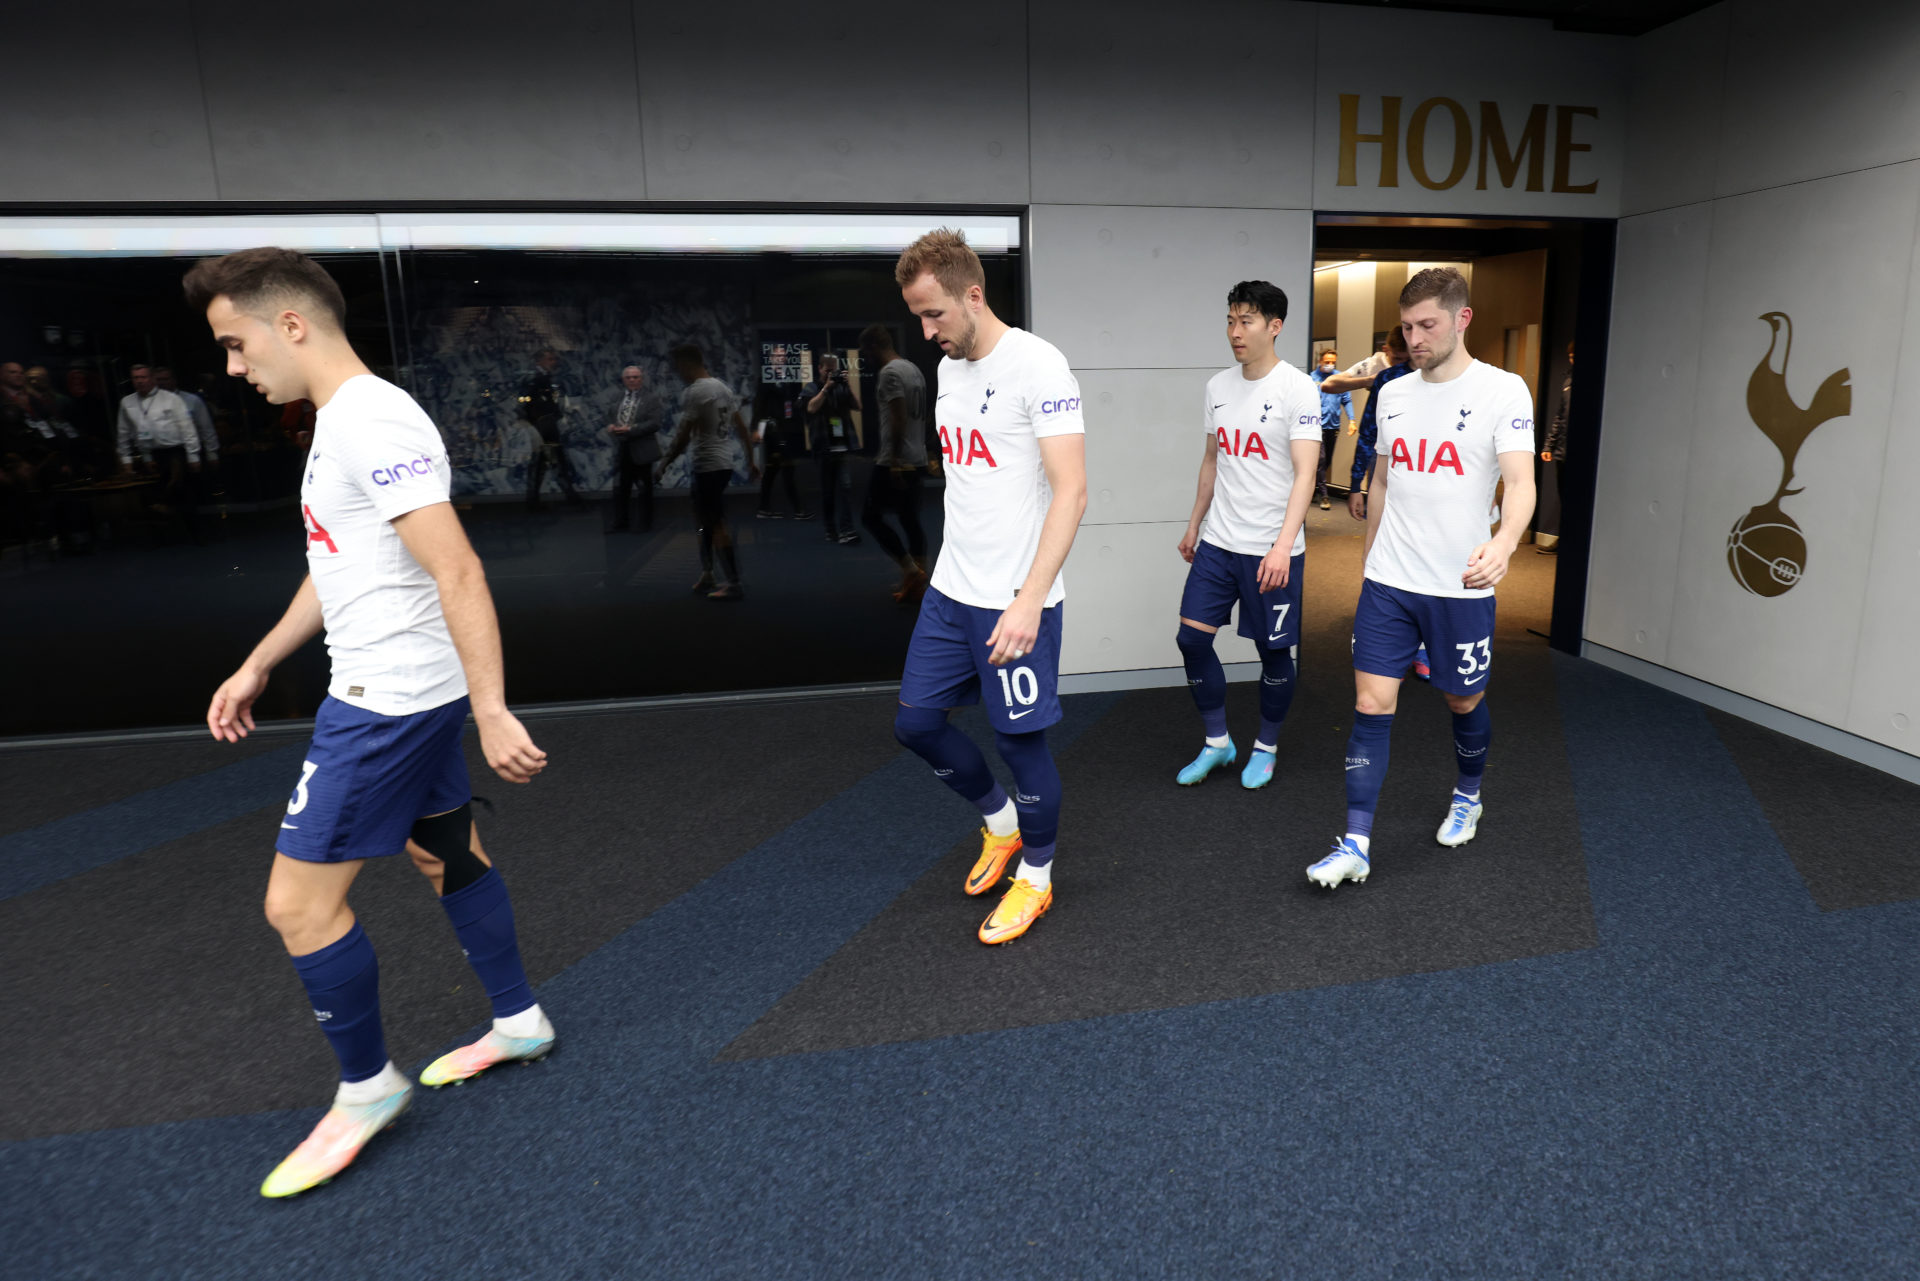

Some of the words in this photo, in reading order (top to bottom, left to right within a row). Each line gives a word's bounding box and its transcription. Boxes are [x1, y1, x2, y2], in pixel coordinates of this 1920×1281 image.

[1336, 94, 1599, 194] HOME
[762, 344, 809, 355] PLEASE
[763, 356, 785, 365] TAKE
[763, 366, 810, 380] SEATS
[938, 425, 997, 467] AIA
[1217, 426, 1269, 460] AIA
[1391, 437, 1464, 475] AIA
[1272, 603, 1290, 632] 7
[1455, 635, 1491, 675] 33
[997, 666, 1039, 707] 10
